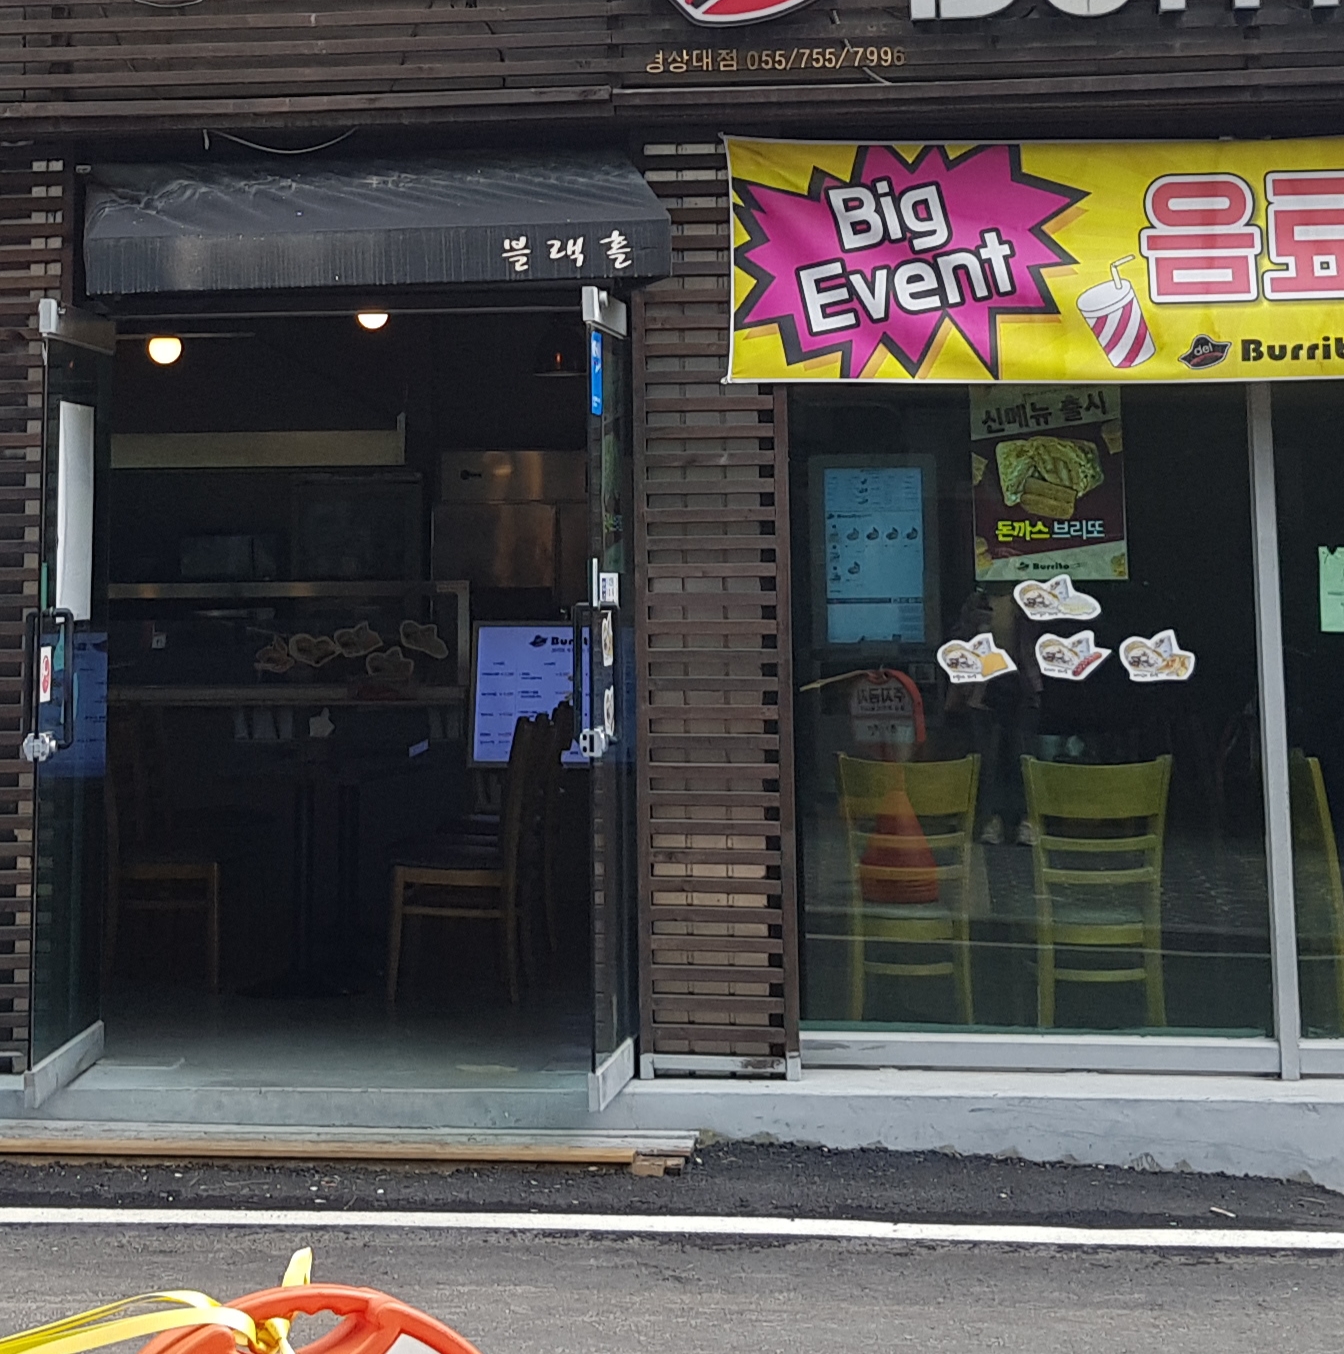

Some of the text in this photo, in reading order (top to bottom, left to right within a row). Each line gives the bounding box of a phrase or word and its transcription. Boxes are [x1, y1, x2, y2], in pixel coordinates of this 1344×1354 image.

[746, 47, 906, 70] 055/755/7996
[827, 177, 951, 252] Big
[797, 228, 1014, 335] Event
[1193, 341, 1214, 356] del
[982, 390, 1108, 434] 신메뉴 출시
[996, 520, 1105, 542] 돈까스 브리또
